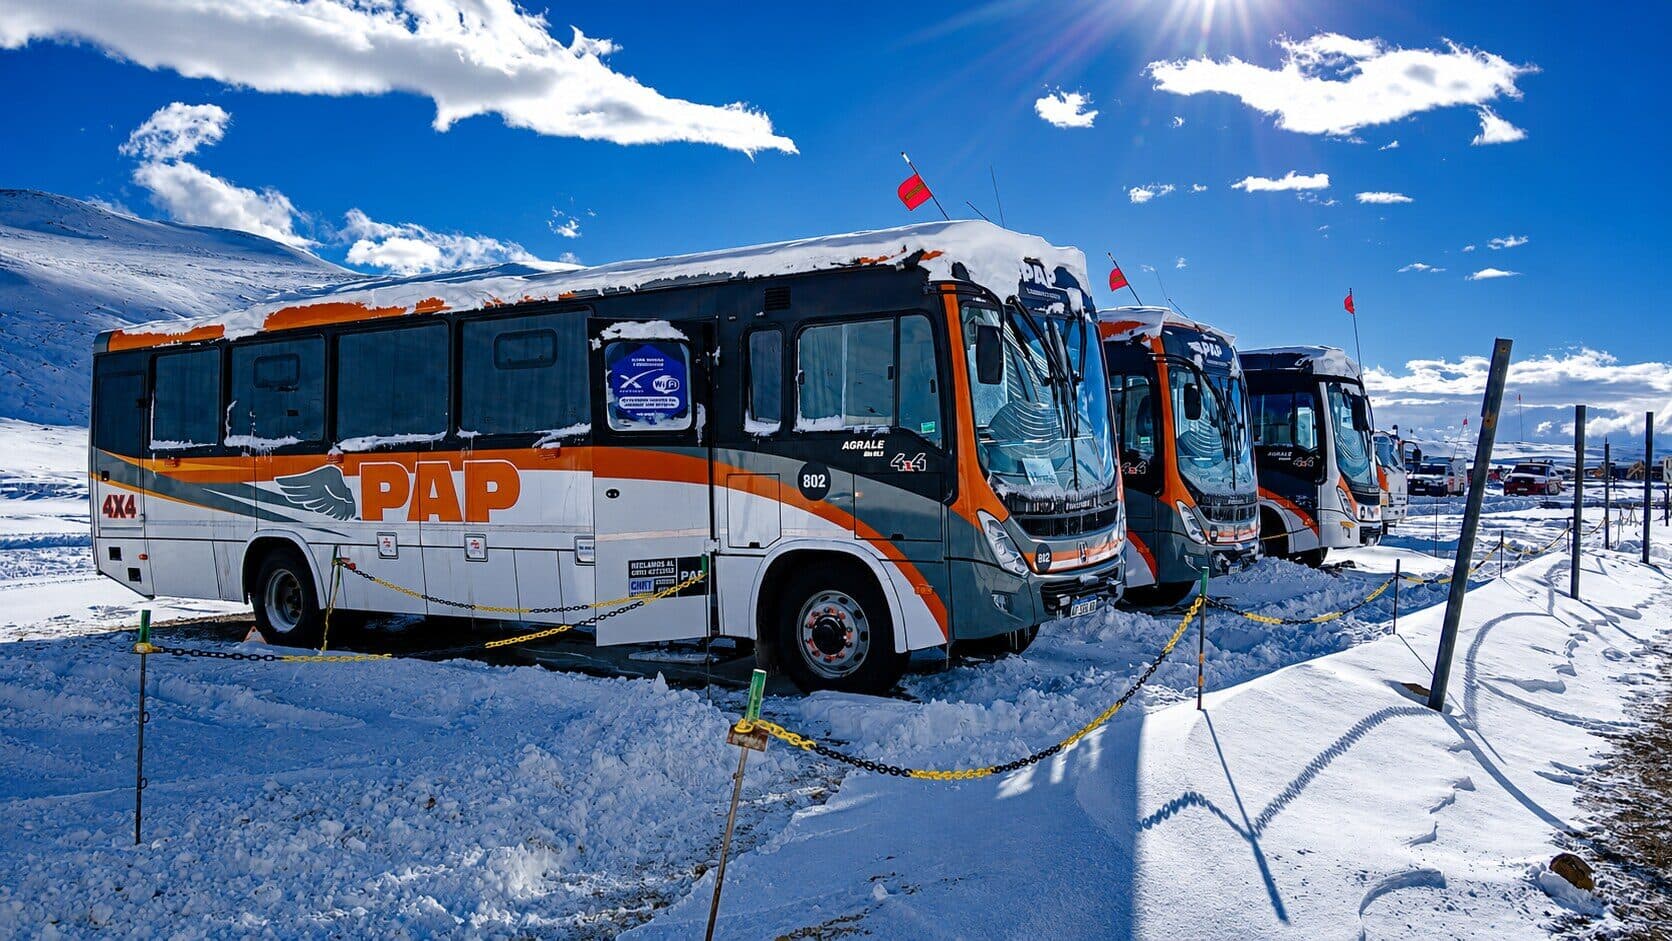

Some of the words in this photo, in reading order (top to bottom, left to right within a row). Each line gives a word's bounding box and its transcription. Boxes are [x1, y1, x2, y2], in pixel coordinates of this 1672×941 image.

[1020, 262, 1056, 287] PAP
[842, 440, 885, 450] AGRALE
[803, 474, 826, 488] 802
[360, 461, 520, 523] PAP
